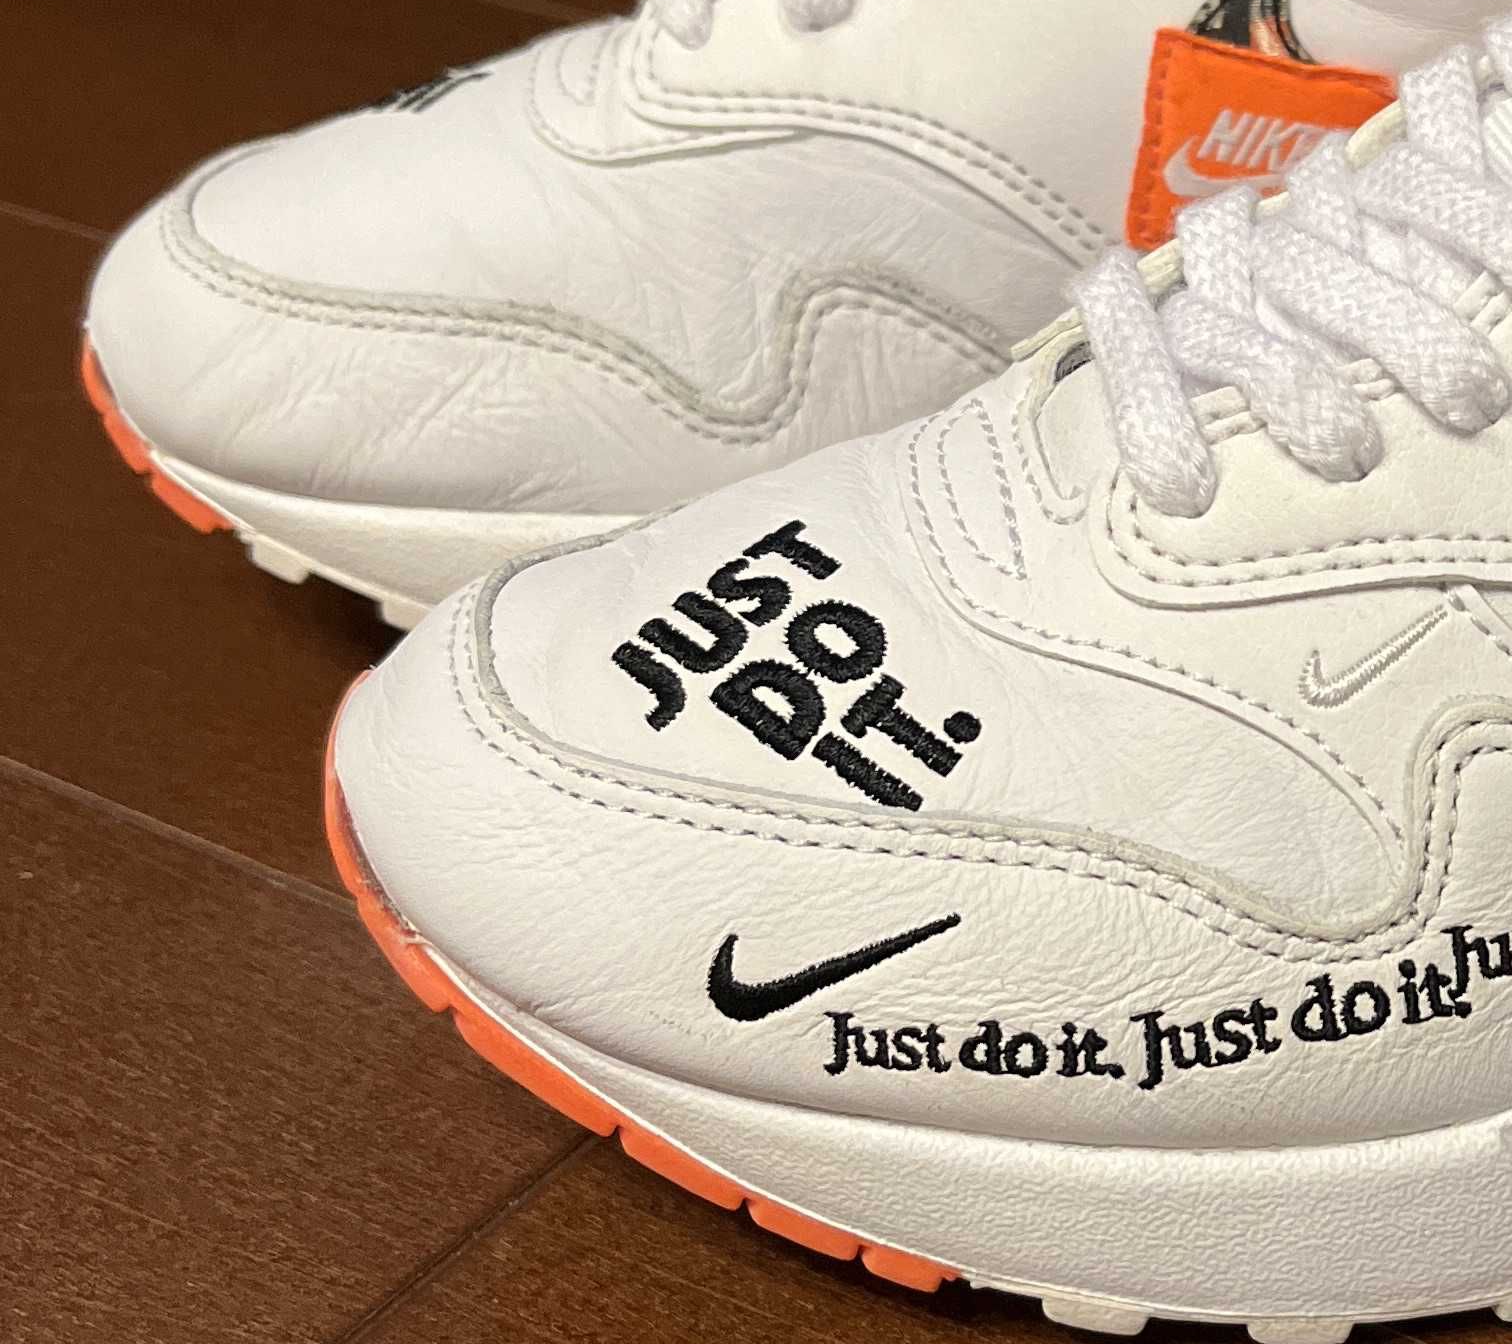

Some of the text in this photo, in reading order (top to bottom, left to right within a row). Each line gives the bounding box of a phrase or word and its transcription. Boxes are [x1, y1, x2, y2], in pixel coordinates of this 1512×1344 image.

[611, 519, 842, 732] JUST
[709, 599, 888, 761] DO
[811, 672, 982, 812] IT.
[823, 1011, 1125, 1079] Just do it.
[1130, 959, 1472, 1090] Just do it.
